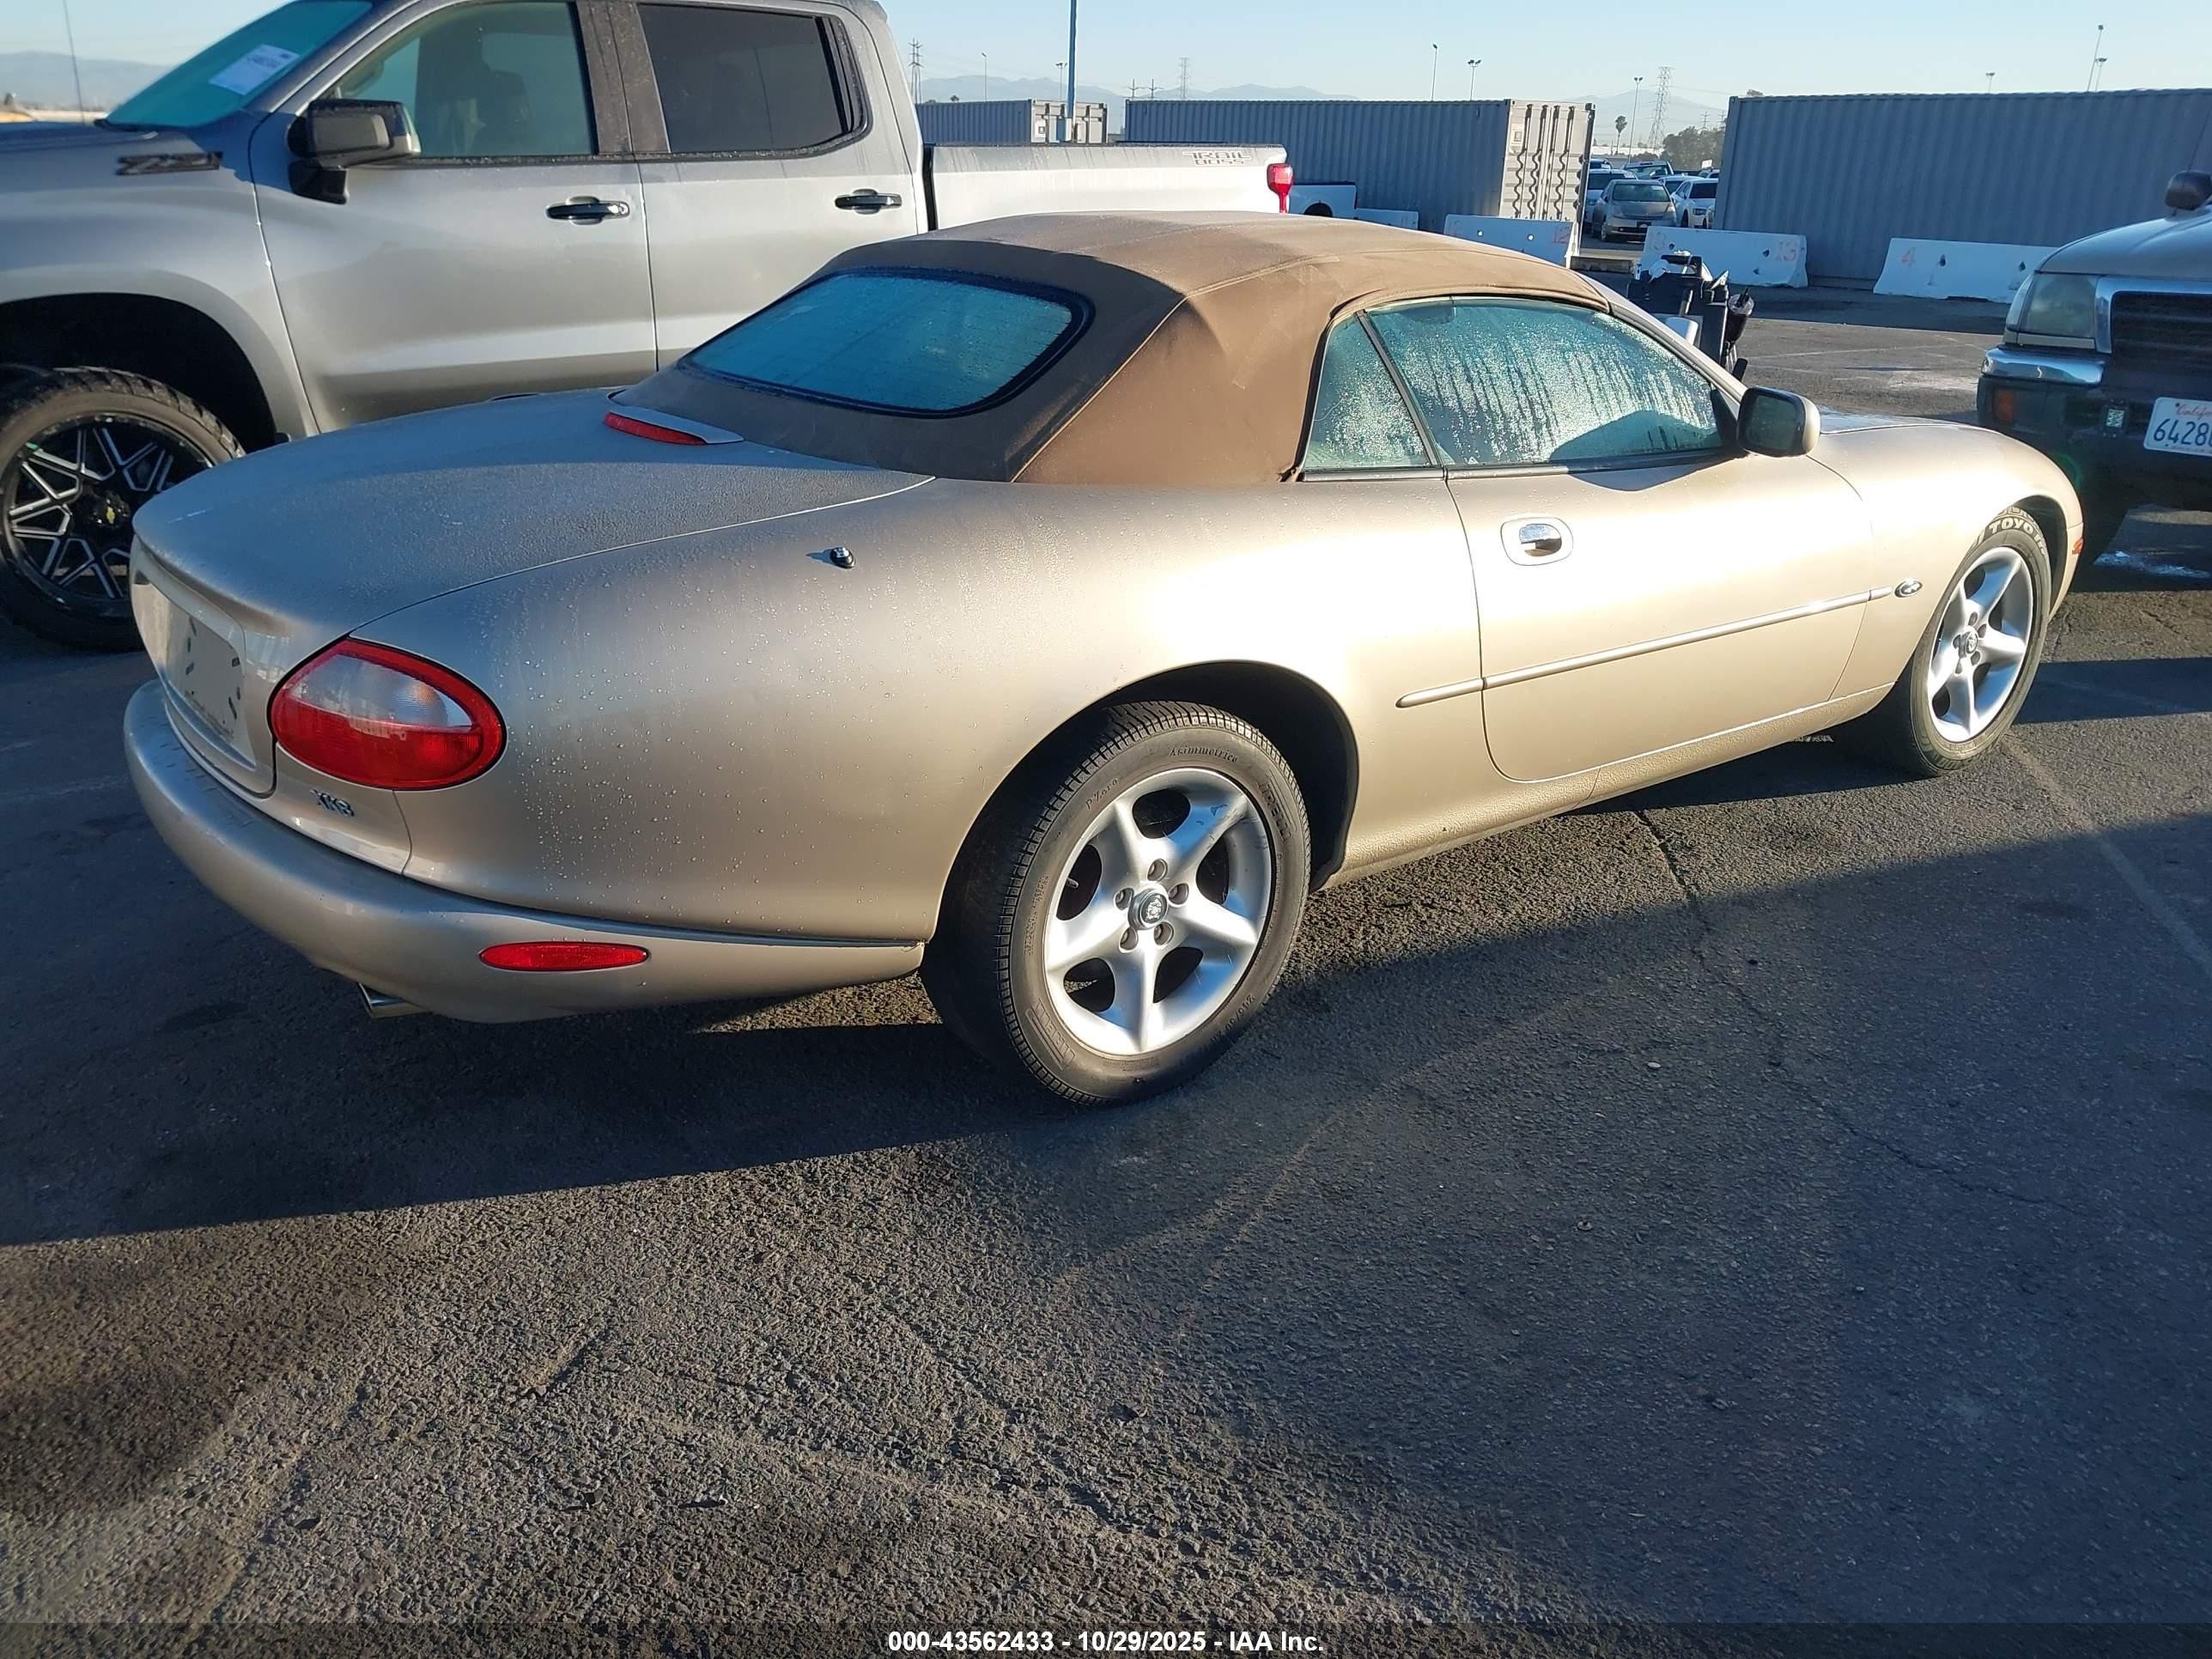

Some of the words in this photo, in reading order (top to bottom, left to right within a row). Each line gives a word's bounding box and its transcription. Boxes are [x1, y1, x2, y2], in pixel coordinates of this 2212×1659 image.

[1182, 150, 1251, 160] TRAIL
[2154, 418, 2212, 447] 6428
[1989, 517, 2034, 534] TOYO
[310, 788, 355, 817] XK8
